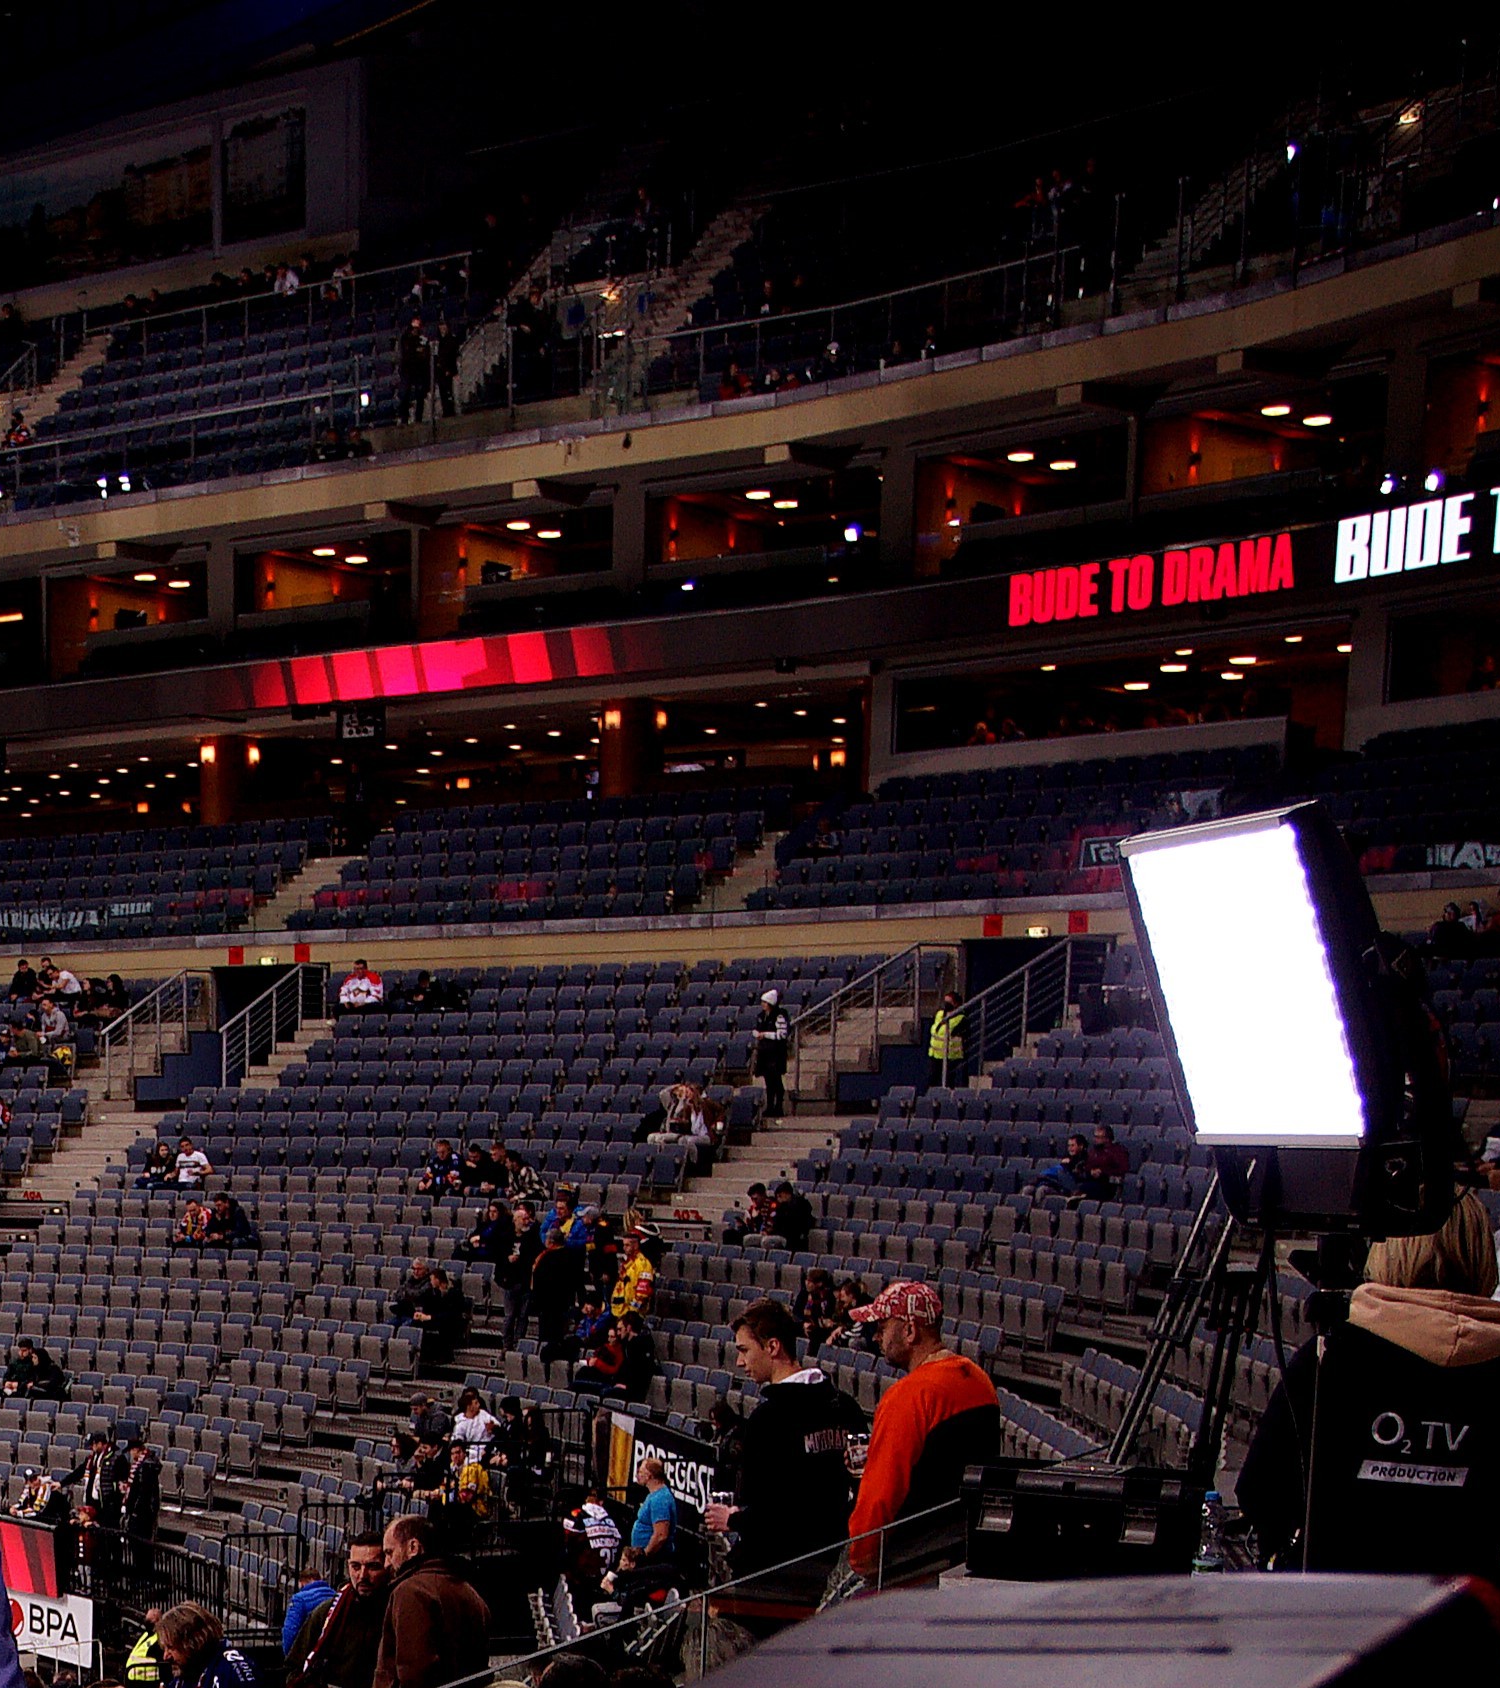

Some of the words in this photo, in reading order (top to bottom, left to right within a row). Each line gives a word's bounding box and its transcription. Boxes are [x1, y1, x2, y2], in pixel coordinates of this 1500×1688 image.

[1334, 491, 1475, 584] BUDE
[1008, 562, 1101, 627] BUDE
[1108, 554, 1156, 613] TO
[1160, 532, 1304, 606] DRAMA
[1421, 1420, 1470, 1452] TV
[1370, 1465, 1456, 1482] PRODUCTION
[29, 1603, 79, 1642] BPA
